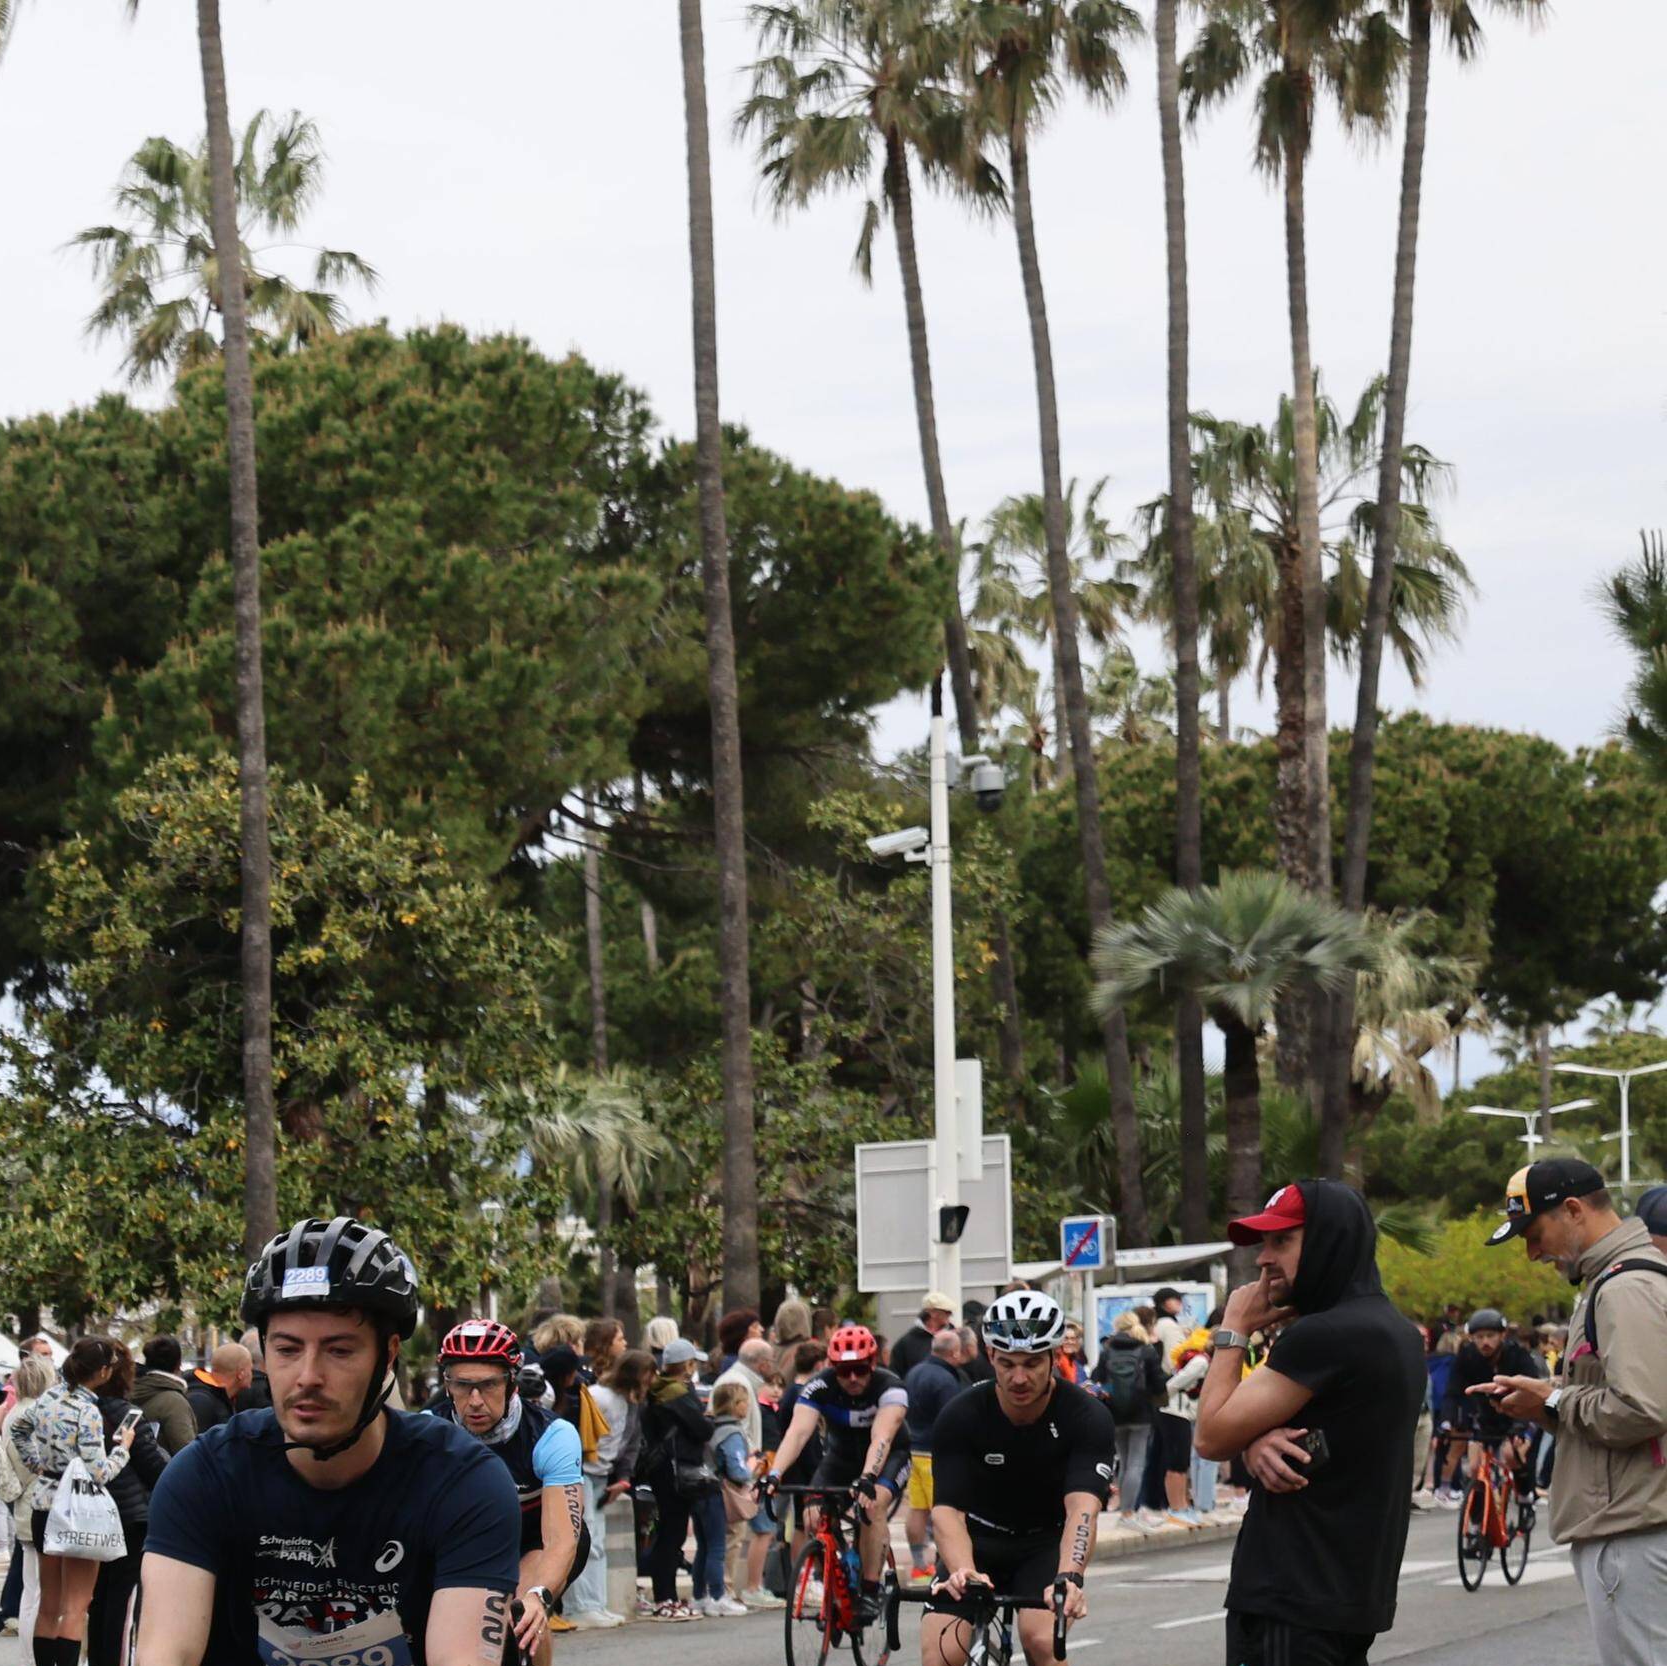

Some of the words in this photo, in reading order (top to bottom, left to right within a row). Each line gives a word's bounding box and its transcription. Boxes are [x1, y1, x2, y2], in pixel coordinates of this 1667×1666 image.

[286, 1268, 326, 1284] 2289
[259, 1535, 313, 1547] Schneider
[253, 1576, 332, 1593] SCHNEIDER
[336, 1578, 400, 1595] ELECTRIC
